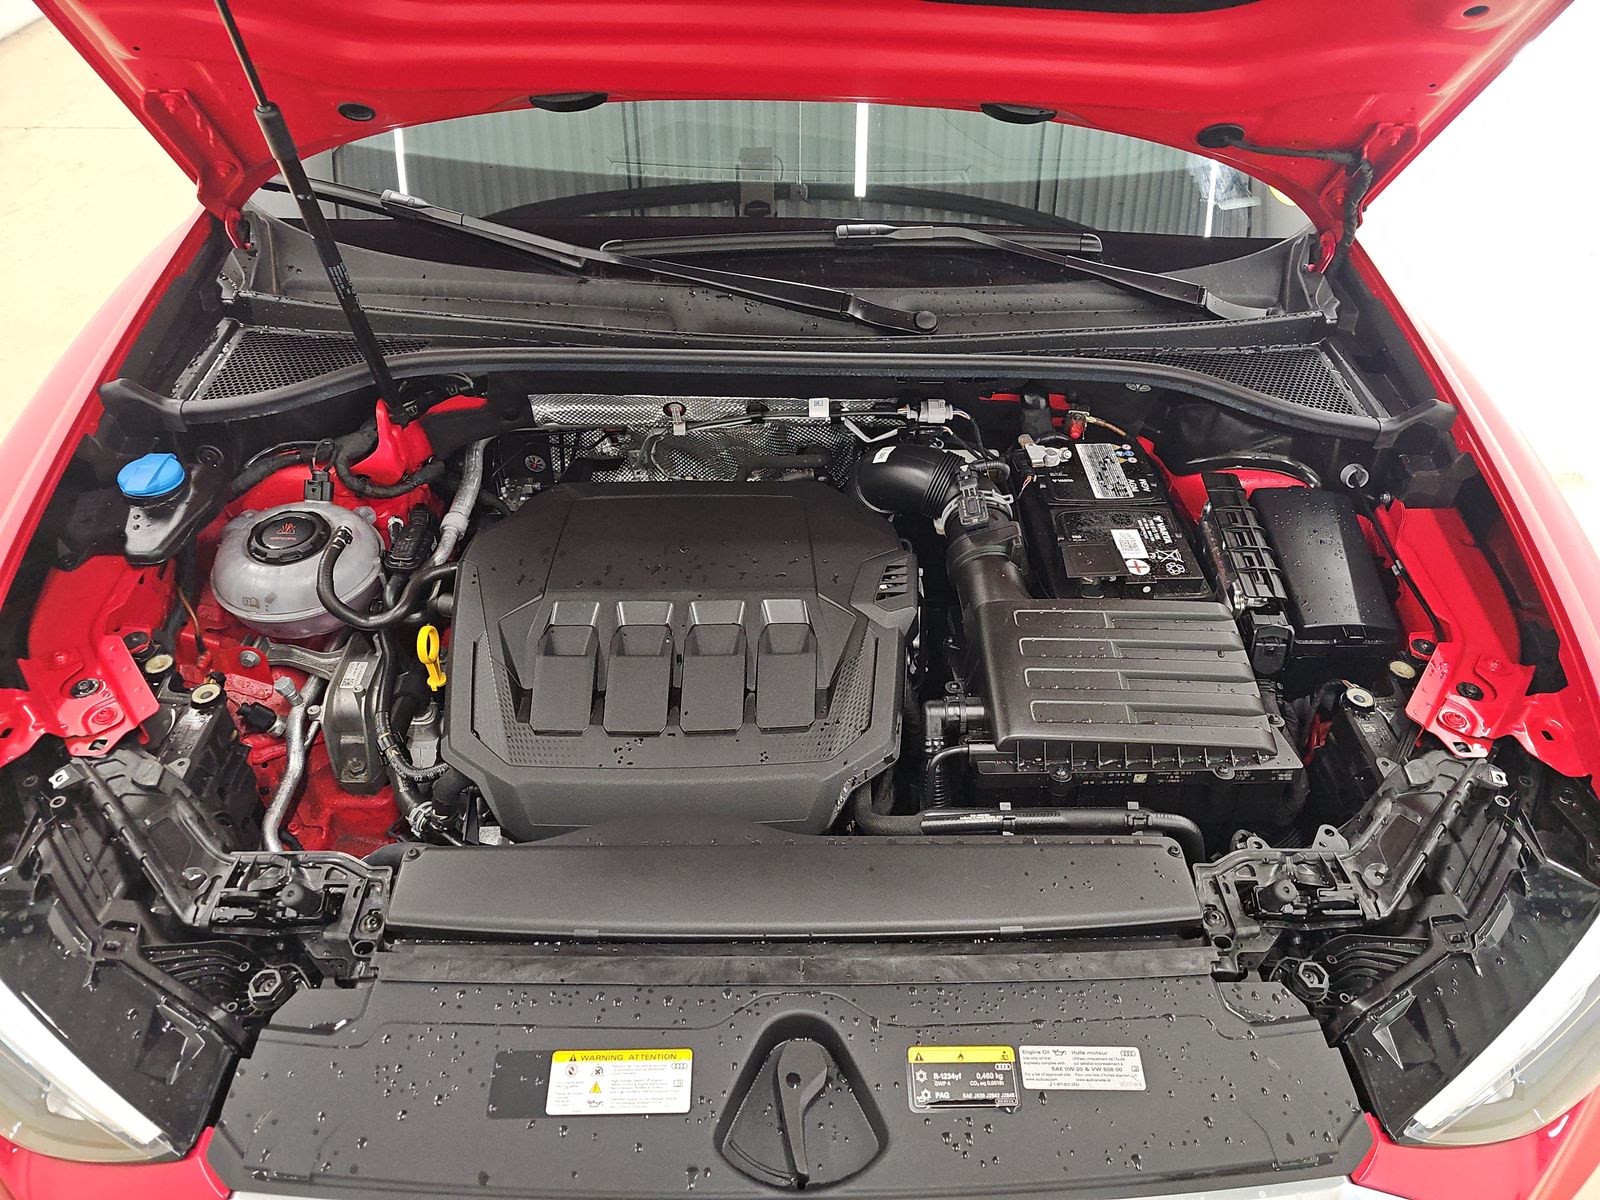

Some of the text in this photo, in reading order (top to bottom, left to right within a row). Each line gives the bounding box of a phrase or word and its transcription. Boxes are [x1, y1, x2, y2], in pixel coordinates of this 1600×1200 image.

[1156, 522, 1173, 544] VARTA
[580, 1053, 678, 1062] WARNING ATTENTION
[933, 1072, 962, 1081] R-1234yf
[994, 1072, 1004, 1080] kg
[934, 1091, 951, 1099] PAG
